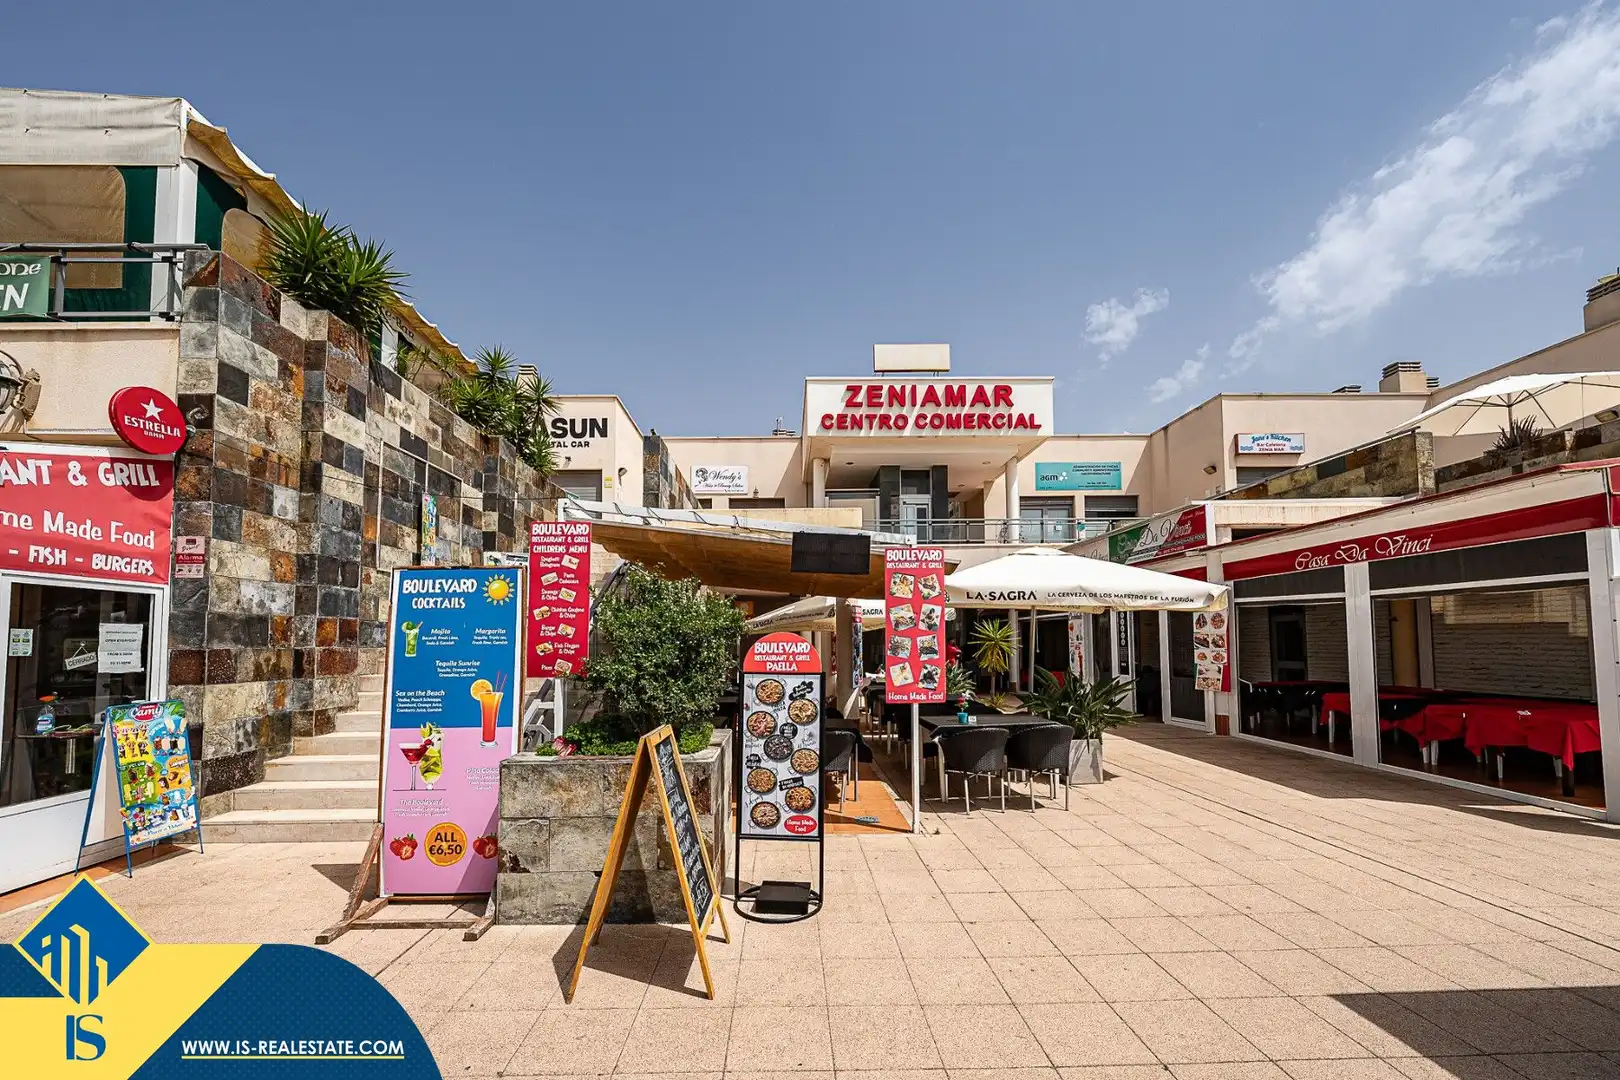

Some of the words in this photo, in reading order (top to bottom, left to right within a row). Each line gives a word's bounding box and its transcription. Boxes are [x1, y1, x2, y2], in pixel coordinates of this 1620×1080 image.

[845, 384, 1015, 408] ZENIAMAR
[124, 415, 181, 438] ESTRELLA
[820, 413, 909, 431] CENTRO
[914, 413, 1042, 431] COMERCIAL
[67, 460, 88, 488] &
[98, 461, 160, 488] GRILL
[709, 468, 742, 483] Wendy's
[43, 510, 103, 541] Made
[111, 521, 155, 549] Food
[532, 523, 589, 535] BOULEVARD
[533, 545, 566, 553] CHILDRENS
[569, 545, 588, 553] MENU
[1295, 551, 1331, 570] Casa
[1335, 544, 1369, 562] Da
[1375, 534, 1433, 556] Vinci
[28, 545, 66, 566] FISH
[92, 553, 154, 576] BURGERS
[886, 550, 942, 561] BOULEVARD
[402, 578, 478, 594] BOULEVARD
[412, 597, 466, 609] COCKTAILS
[1114, 593, 1147, 601] MAESTROS
[862, 608, 884, 616] SAGRA
[431, 628, 451, 636] Mojito
[475, 627, 506, 635] Margarita
[754, 642, 810, 653] BOULEVARD
[67, 654, 95, 667] CERRADO
[766, 662, 798, 671] PAELLA
[889, 692, 908, 700] Home
[910, 691, 927, 700] Made
[928, 691, 943, 700] Food
[434, 832, 457, 843] ALL
[429, 844, 462, 856] €6,50
